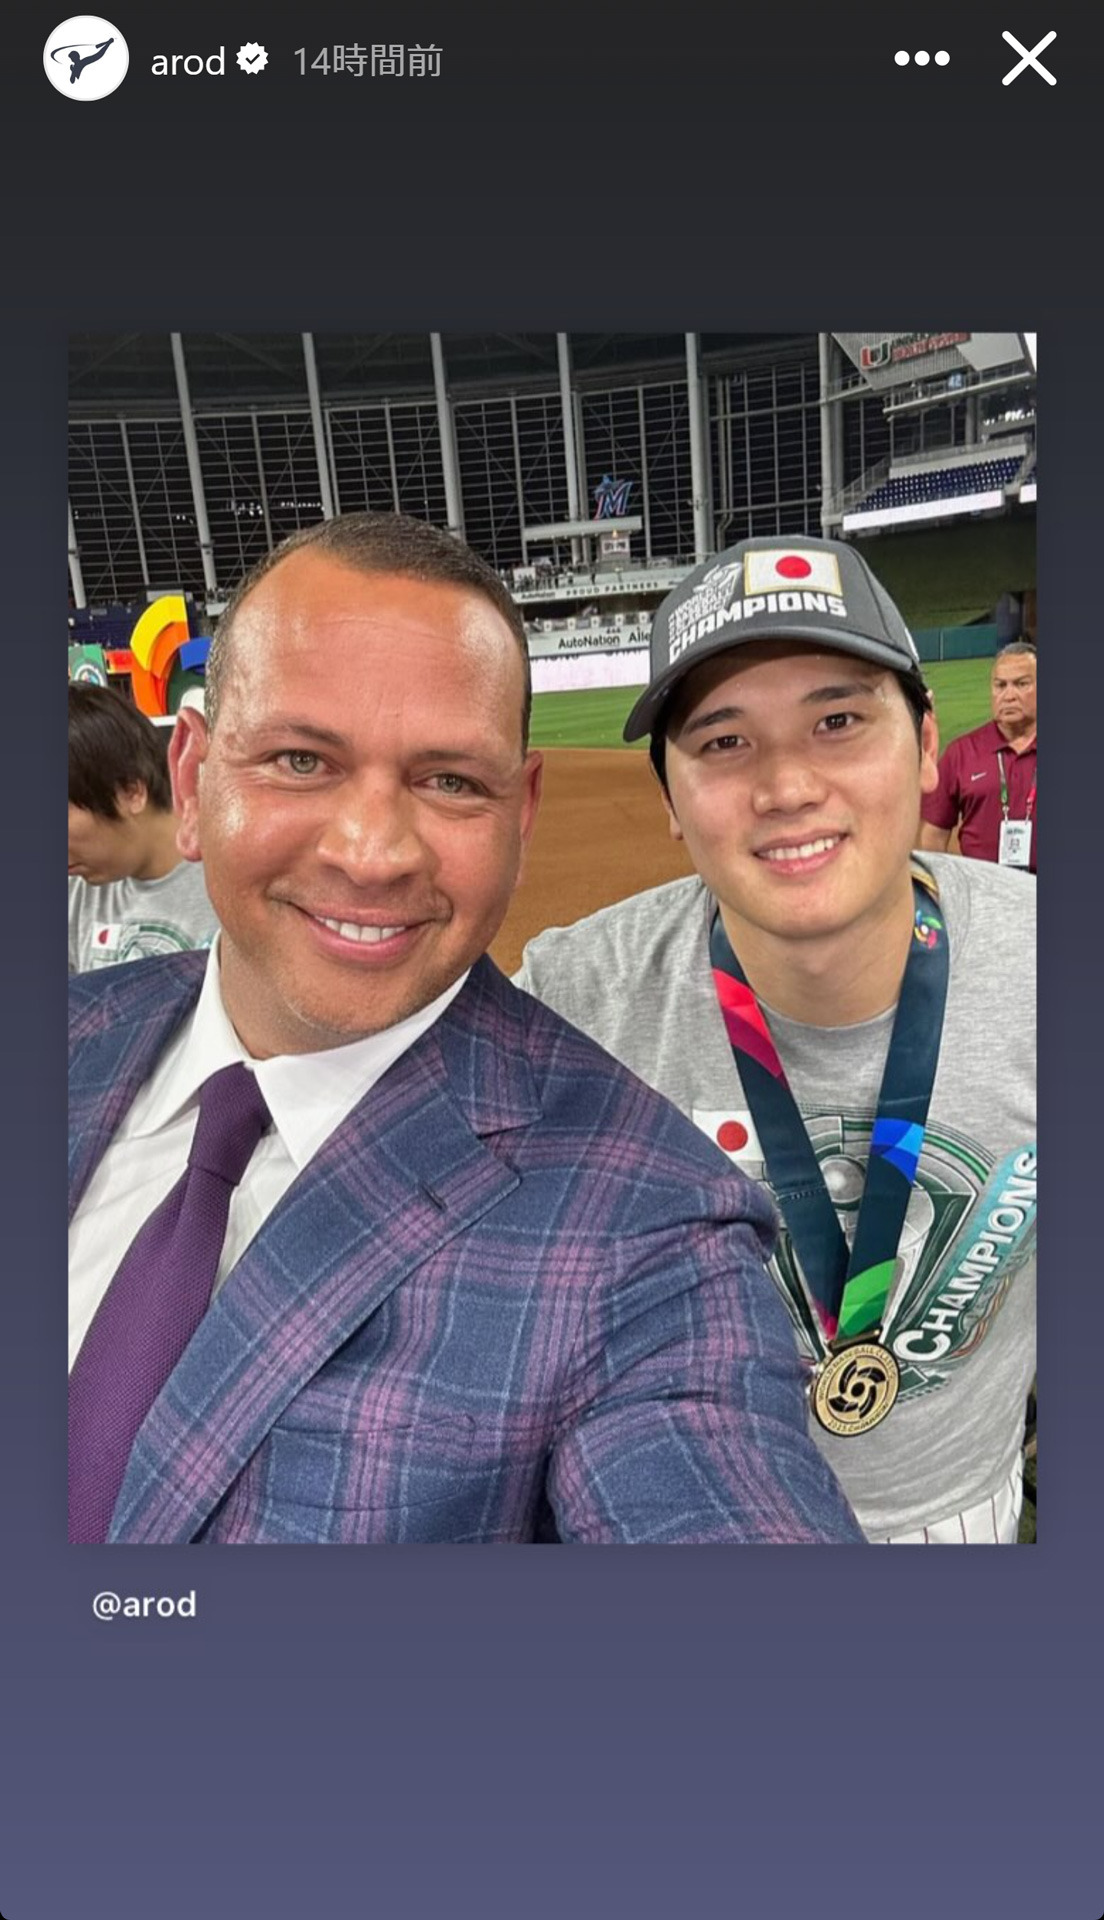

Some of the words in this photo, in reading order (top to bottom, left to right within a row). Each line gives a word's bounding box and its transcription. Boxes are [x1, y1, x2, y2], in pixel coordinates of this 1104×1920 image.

[566, 586, 600, 597] PROUD
[605, 581, 658, 592] PARTNERS
[668, 593, 848, 666] CHAMPIONS
[557, 634, 621, 650] AutoNation
